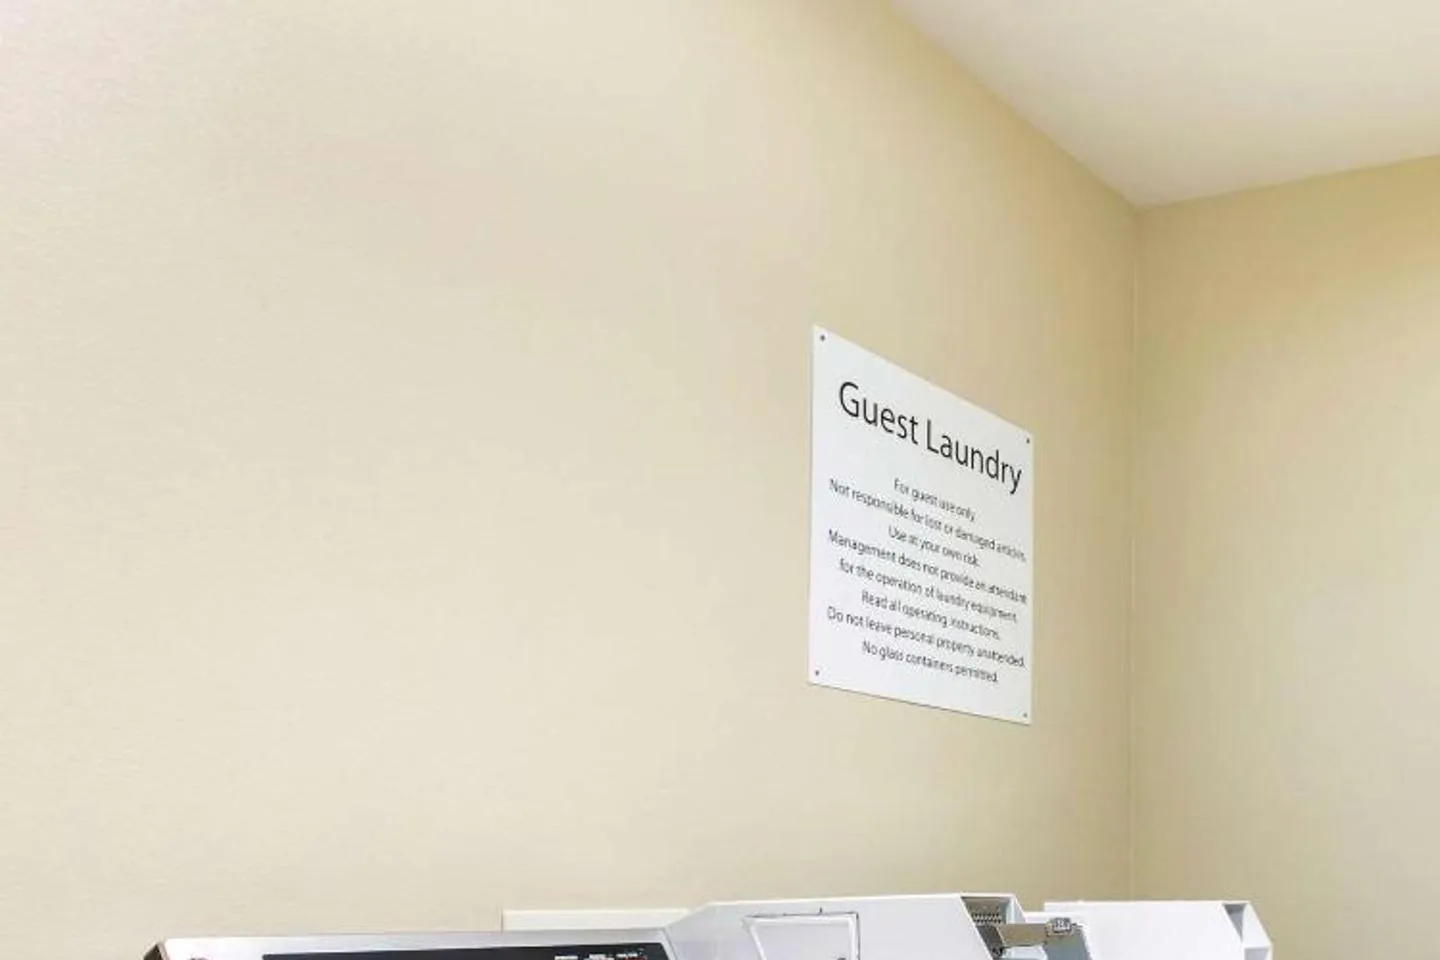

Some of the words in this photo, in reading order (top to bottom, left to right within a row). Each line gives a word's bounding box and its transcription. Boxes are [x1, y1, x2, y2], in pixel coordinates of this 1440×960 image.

[839, 381, 919, 445] Guest
[926, 418, 1022, 495] Laundry
[894, 478, 909, 493] For
[829, 478, 850, 498] Not
[852, 489, 909, 519] responsible
[888, 525, 907, 543] Use
[829, 528, 895, 564] Management
[898, 553, 921, 573] does
[875, 571, 922, 595] operation
[861, 588, 888, 608] Read
[827, 606, 843, 623] Do
[846, 612, 864, 629] not
[865, 615, 891, 635] leave
[894, 625, 935, 646] personal
[862, 640, 878, 656] No
